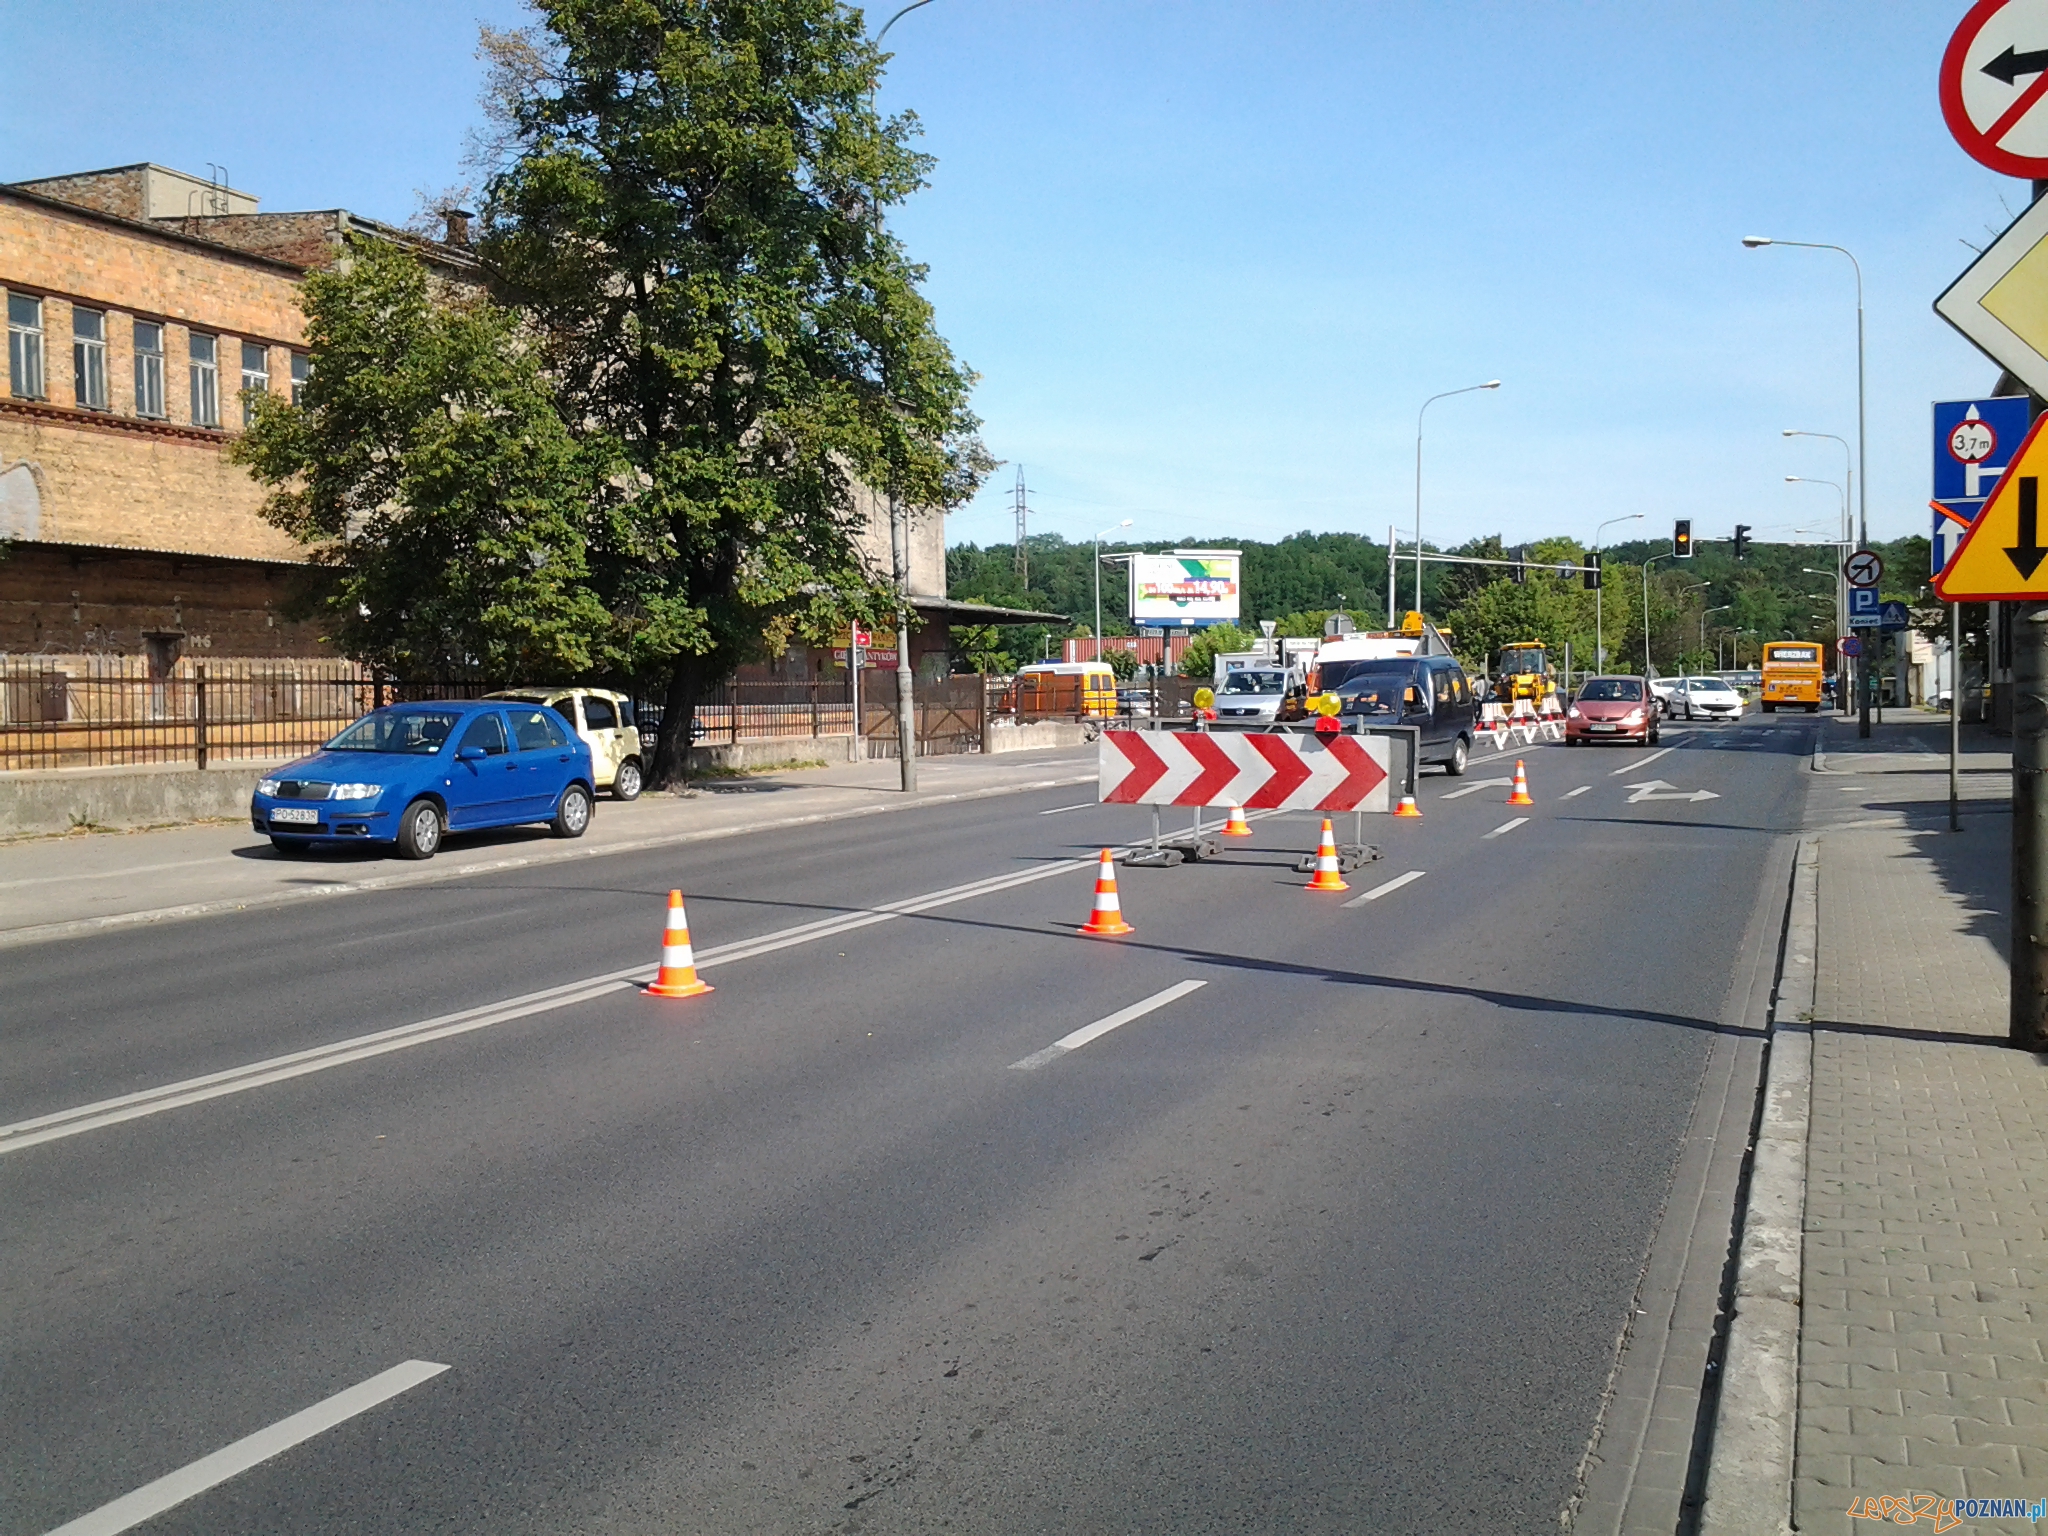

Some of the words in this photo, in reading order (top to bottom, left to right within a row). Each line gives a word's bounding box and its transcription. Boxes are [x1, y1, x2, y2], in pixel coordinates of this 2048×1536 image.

[1954, 434, 1977, 452] 3,7
[1979, 441, 1990, 449] m
[1856, 591, 1873, 612] P
